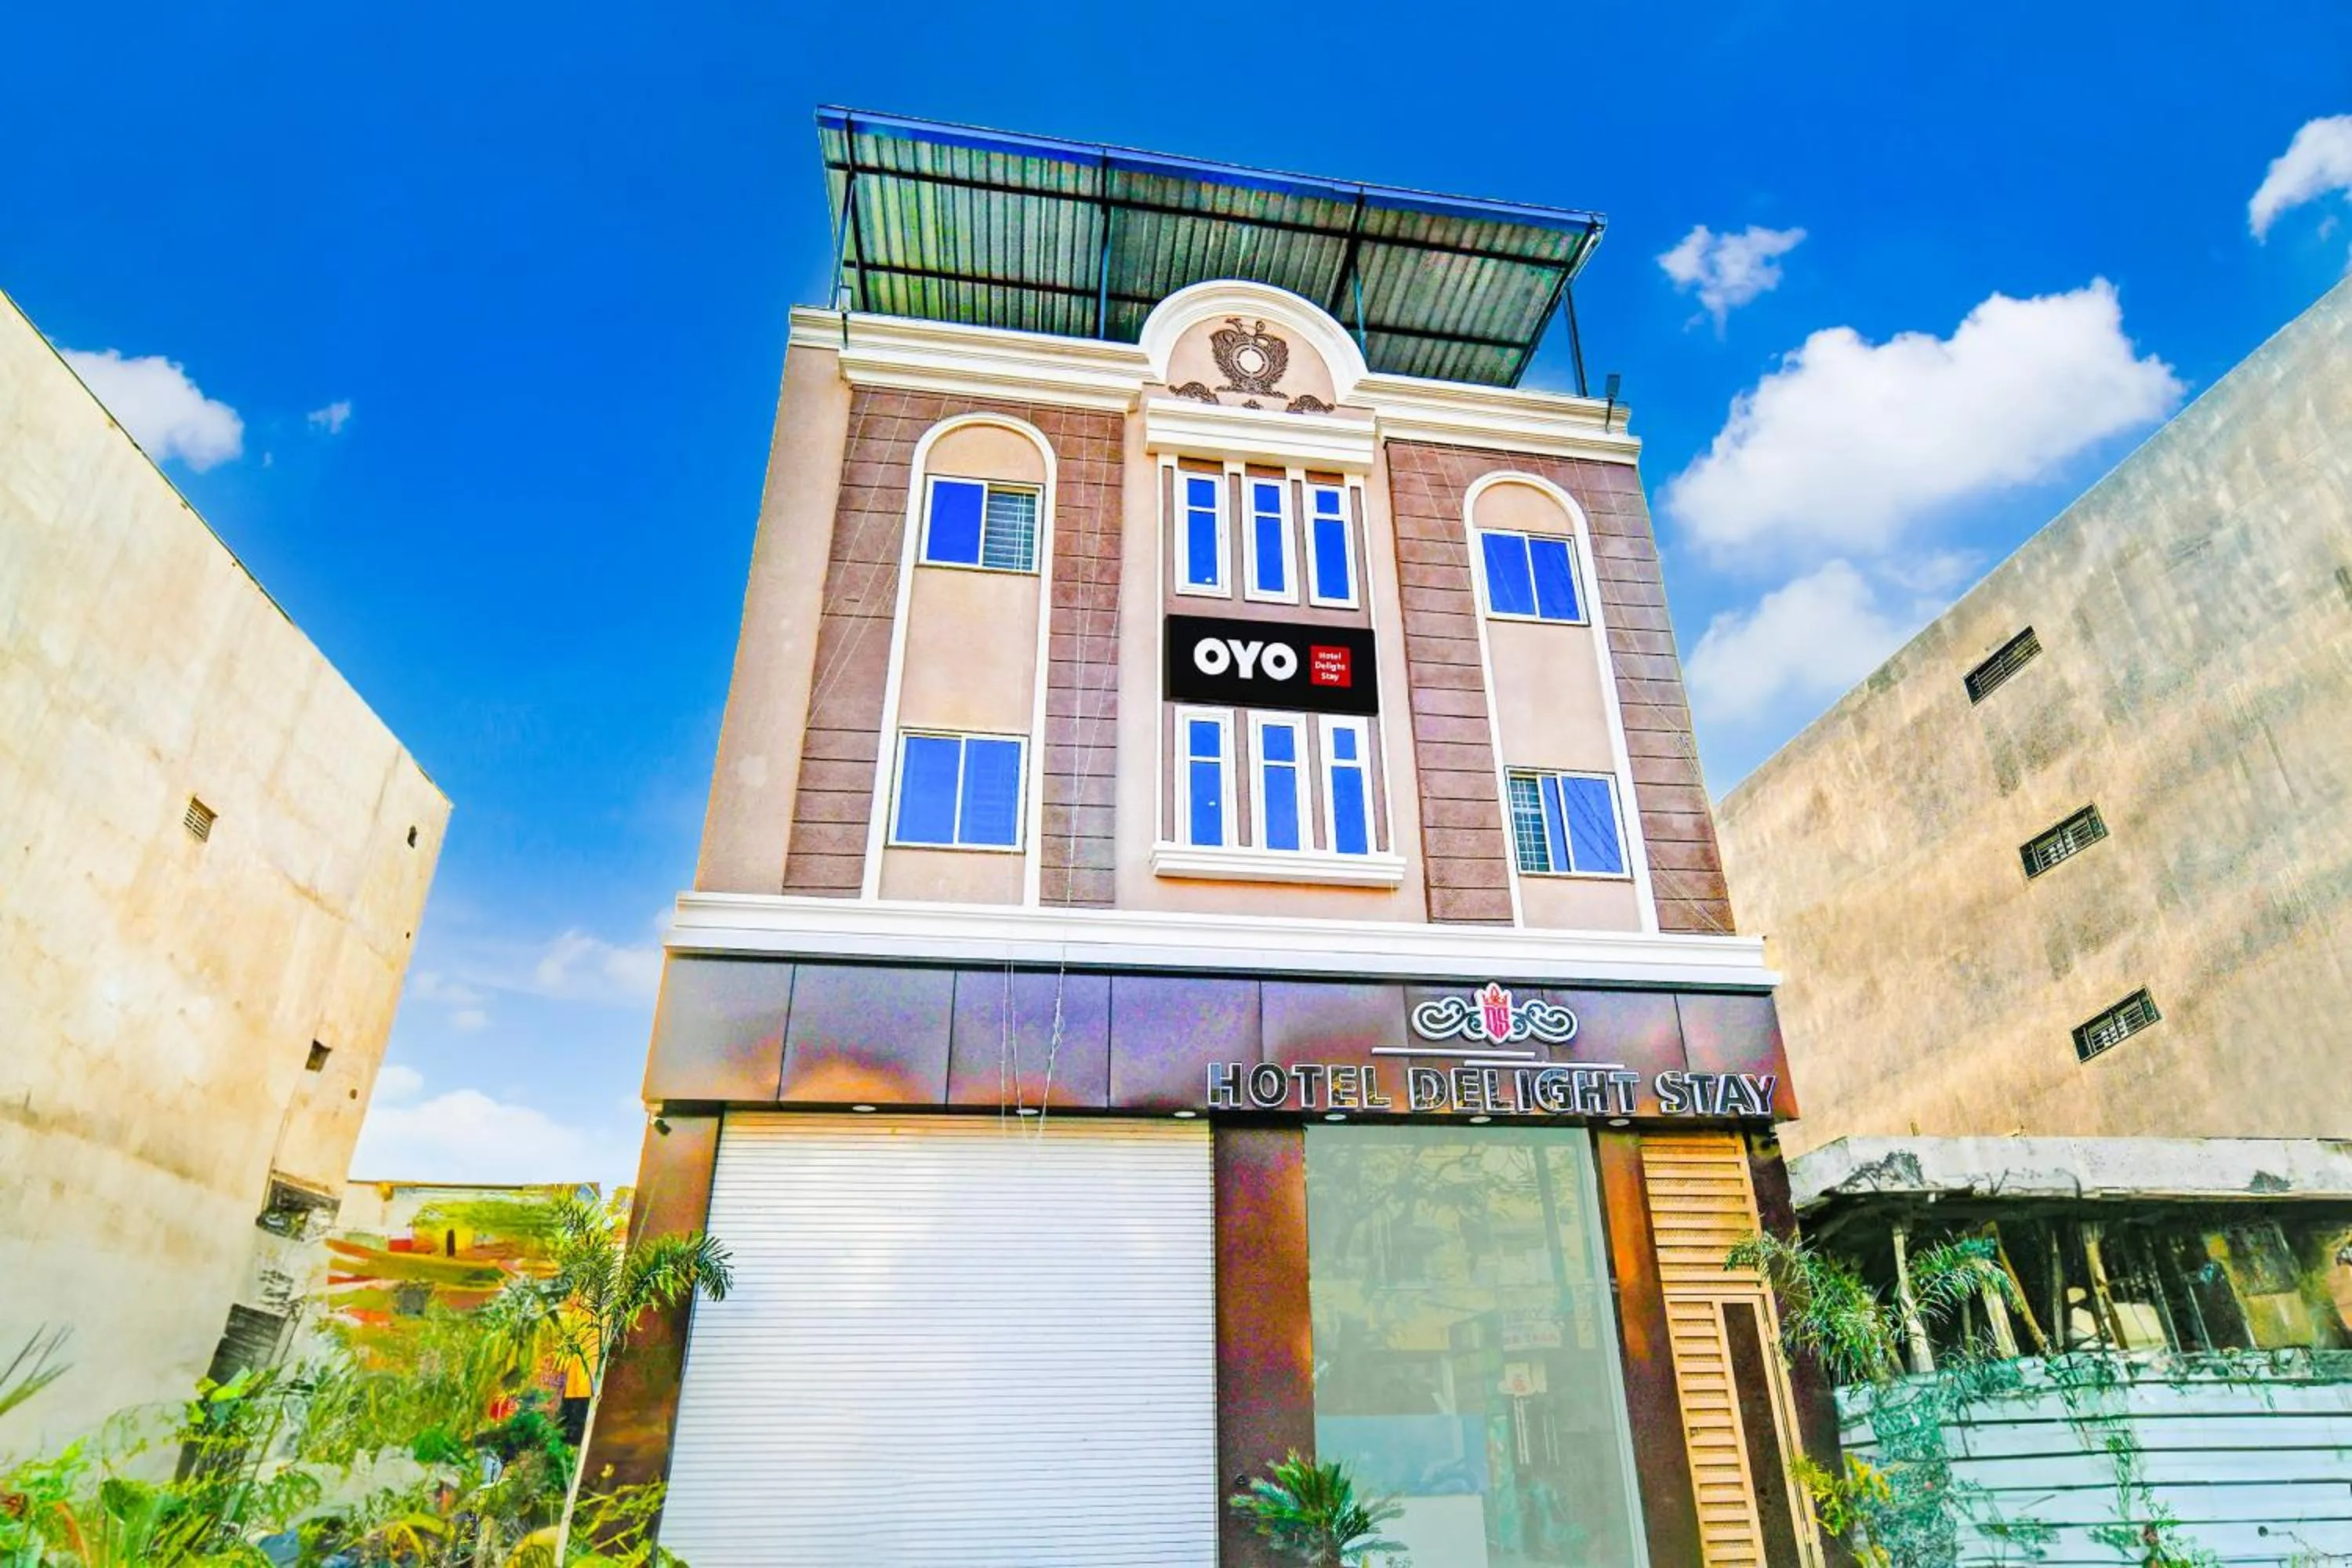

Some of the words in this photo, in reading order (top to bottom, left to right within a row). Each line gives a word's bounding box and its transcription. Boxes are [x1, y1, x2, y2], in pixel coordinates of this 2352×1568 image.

[1193, 637, 1298, 681] OYO
[1318, 652, 1341, 660] Hotel
[1315, 661, 1346, 672] Delight
[1321, 672, 1340, 682] Stay
[1207, 1062, 1392, 1109] HOTEL
[1408, 1067, 1640, 1112] DELIGHT
[1654, 1071, 1777, 1115] STAY
